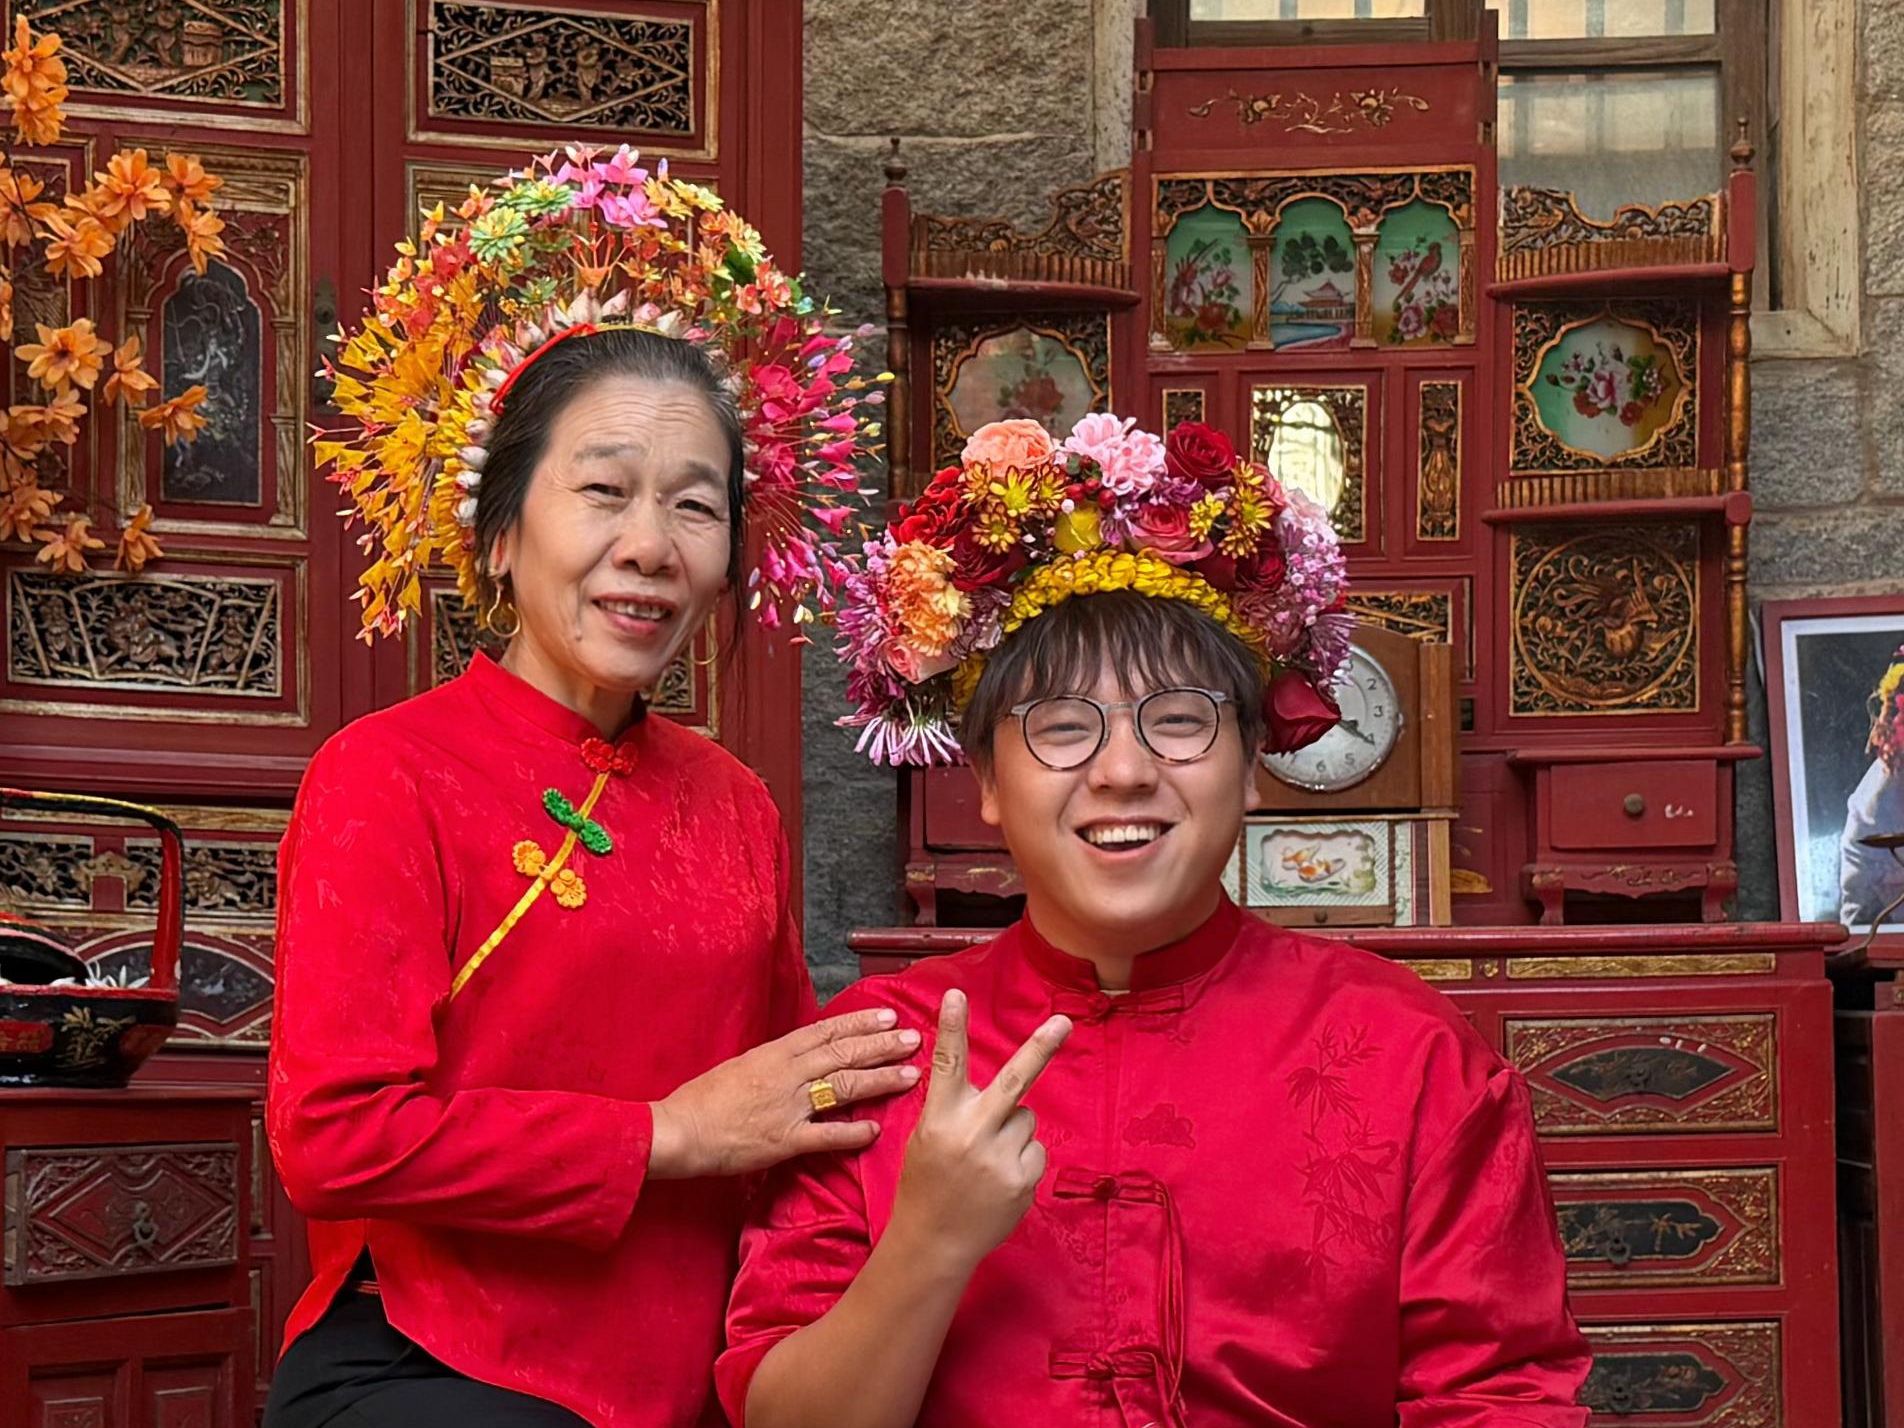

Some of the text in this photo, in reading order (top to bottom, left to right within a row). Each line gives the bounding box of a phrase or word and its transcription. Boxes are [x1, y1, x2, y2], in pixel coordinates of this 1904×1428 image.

[1367, 678, 1377, 690] 2
[1374, 706, 1383, 718] 3
[1345, 753, 1355, 765] 5
[1316, 760, 1326, 772] 6
